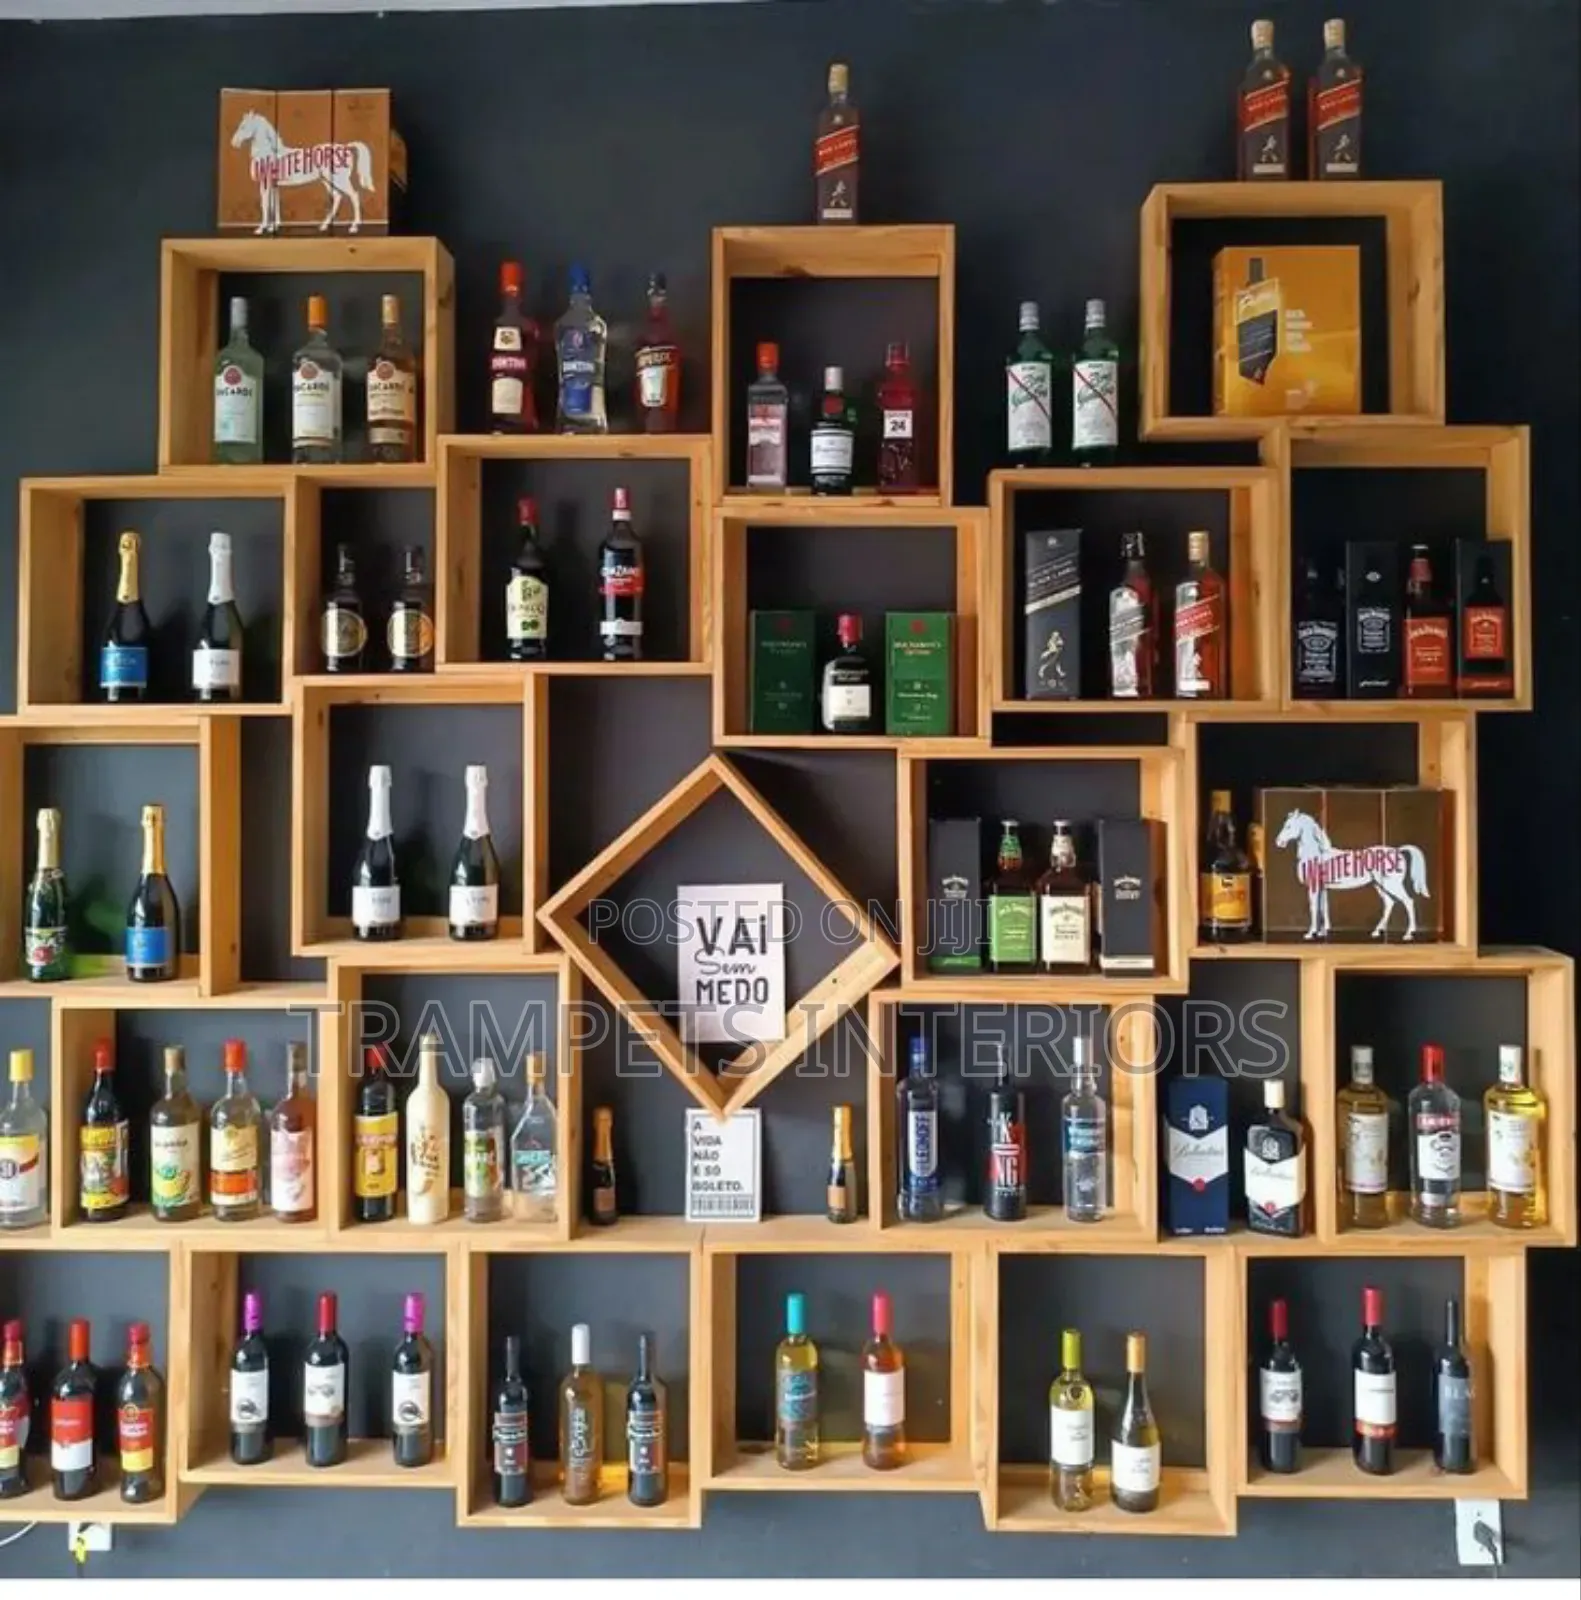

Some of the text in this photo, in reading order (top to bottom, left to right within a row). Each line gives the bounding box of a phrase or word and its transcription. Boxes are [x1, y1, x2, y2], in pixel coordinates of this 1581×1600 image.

[255, 145, 351, 189] WHITE HORSE
[1302, 848, 1404, 893] WHITE HORSE
[696, 977, 769, 1005] MEDO
[693, 1121, 702, 1131] A
[693, 1135, 722, 1146] VIDA
